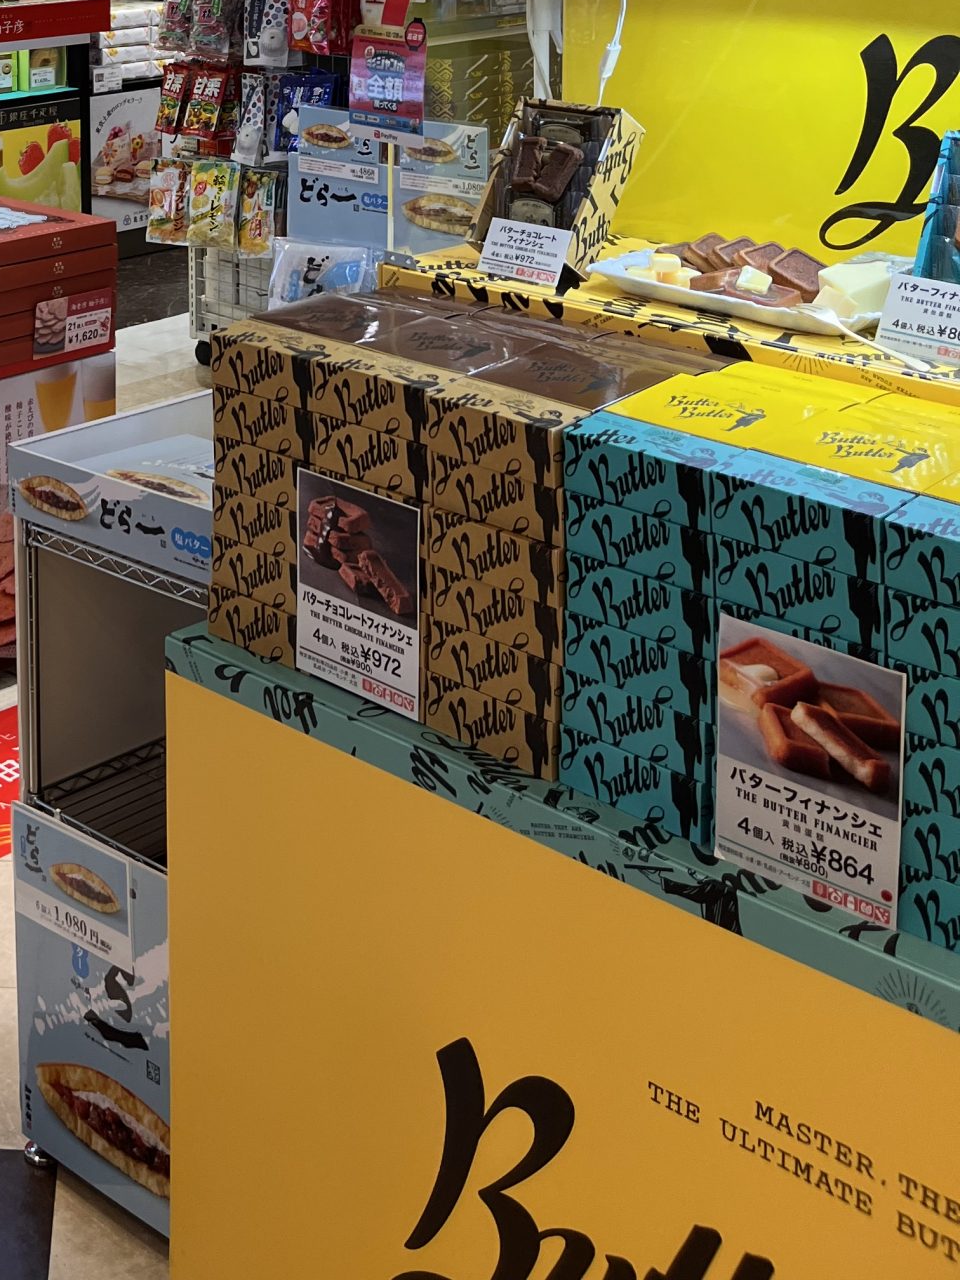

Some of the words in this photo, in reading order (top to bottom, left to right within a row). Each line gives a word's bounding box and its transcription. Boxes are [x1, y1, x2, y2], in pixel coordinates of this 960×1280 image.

[163, 73, 185, 94] 甘栗
[193, 76, 221, 98] 甘栗
[367, 74, 404, 102] 全額
[500, 226, 557, 241] バターチョコレート
[507, 236, 544, 249] フィナンシェ
[515, 254, 534, 264] ¥972
[70, 301, 87, 312] 海老彦
[88, 298, 106, 309] 柚子彦
[900, 295, 913, 303] THE
[916, 298, 941, 308] BUTTER
[68, 327, 99, 344] ¥1,620
[892, 319, 913, 331] 4個入
[916, 324, 935, 336] 税込
[228, 347, 284, 397] Butler
[338, 375, 397, 434] Butler
[666, 393, 720, 412] Butter
[678, 404, 739, 423] Butler
[817, 430, 881, 449] Butter
[832, 443, 900, 461] Butler
[458, 467, 525, 522] Butler
[174, 533, 210, 552] 塩バター
[231, 503, 283, 547] Butler
[592, 509, 671, 569] Butler
[745, 560, 835, 624] Butler
[303, 591, 413, 646] バターチョコレートフィナンシェ
[310, 610, 320, 620] THE
[322, 613, 342, 629] BUTTER
[344, 623, 374, 642] CHOCOLATE
[376, 635, 405, 655] FINANCIER
[313, 628, 337, 649] 4個入
[341, 642, 359, 659] 税込
[360, 644, 401, 678] ¥972
[453, 640, 518, 692] Butler
[586, 693, 667, 748] Butler
[730, 766, 883, 839] バターフィナンシェ
[736, 787, 757, 804] THE
[763, 798, 807, 824] BUTTER
[814, 818, 878, 852] FINANCIER
[737, 817, 775, 845] 4個入
[781, 836, 808, 858] 税込
[811, 841, 875, 885] ¥864
[648, 1080, 701, 1124] THE
[719, 1118, 874, 1218] ULTIMATE
[752, 1099, 889, 1188] MASTER.
